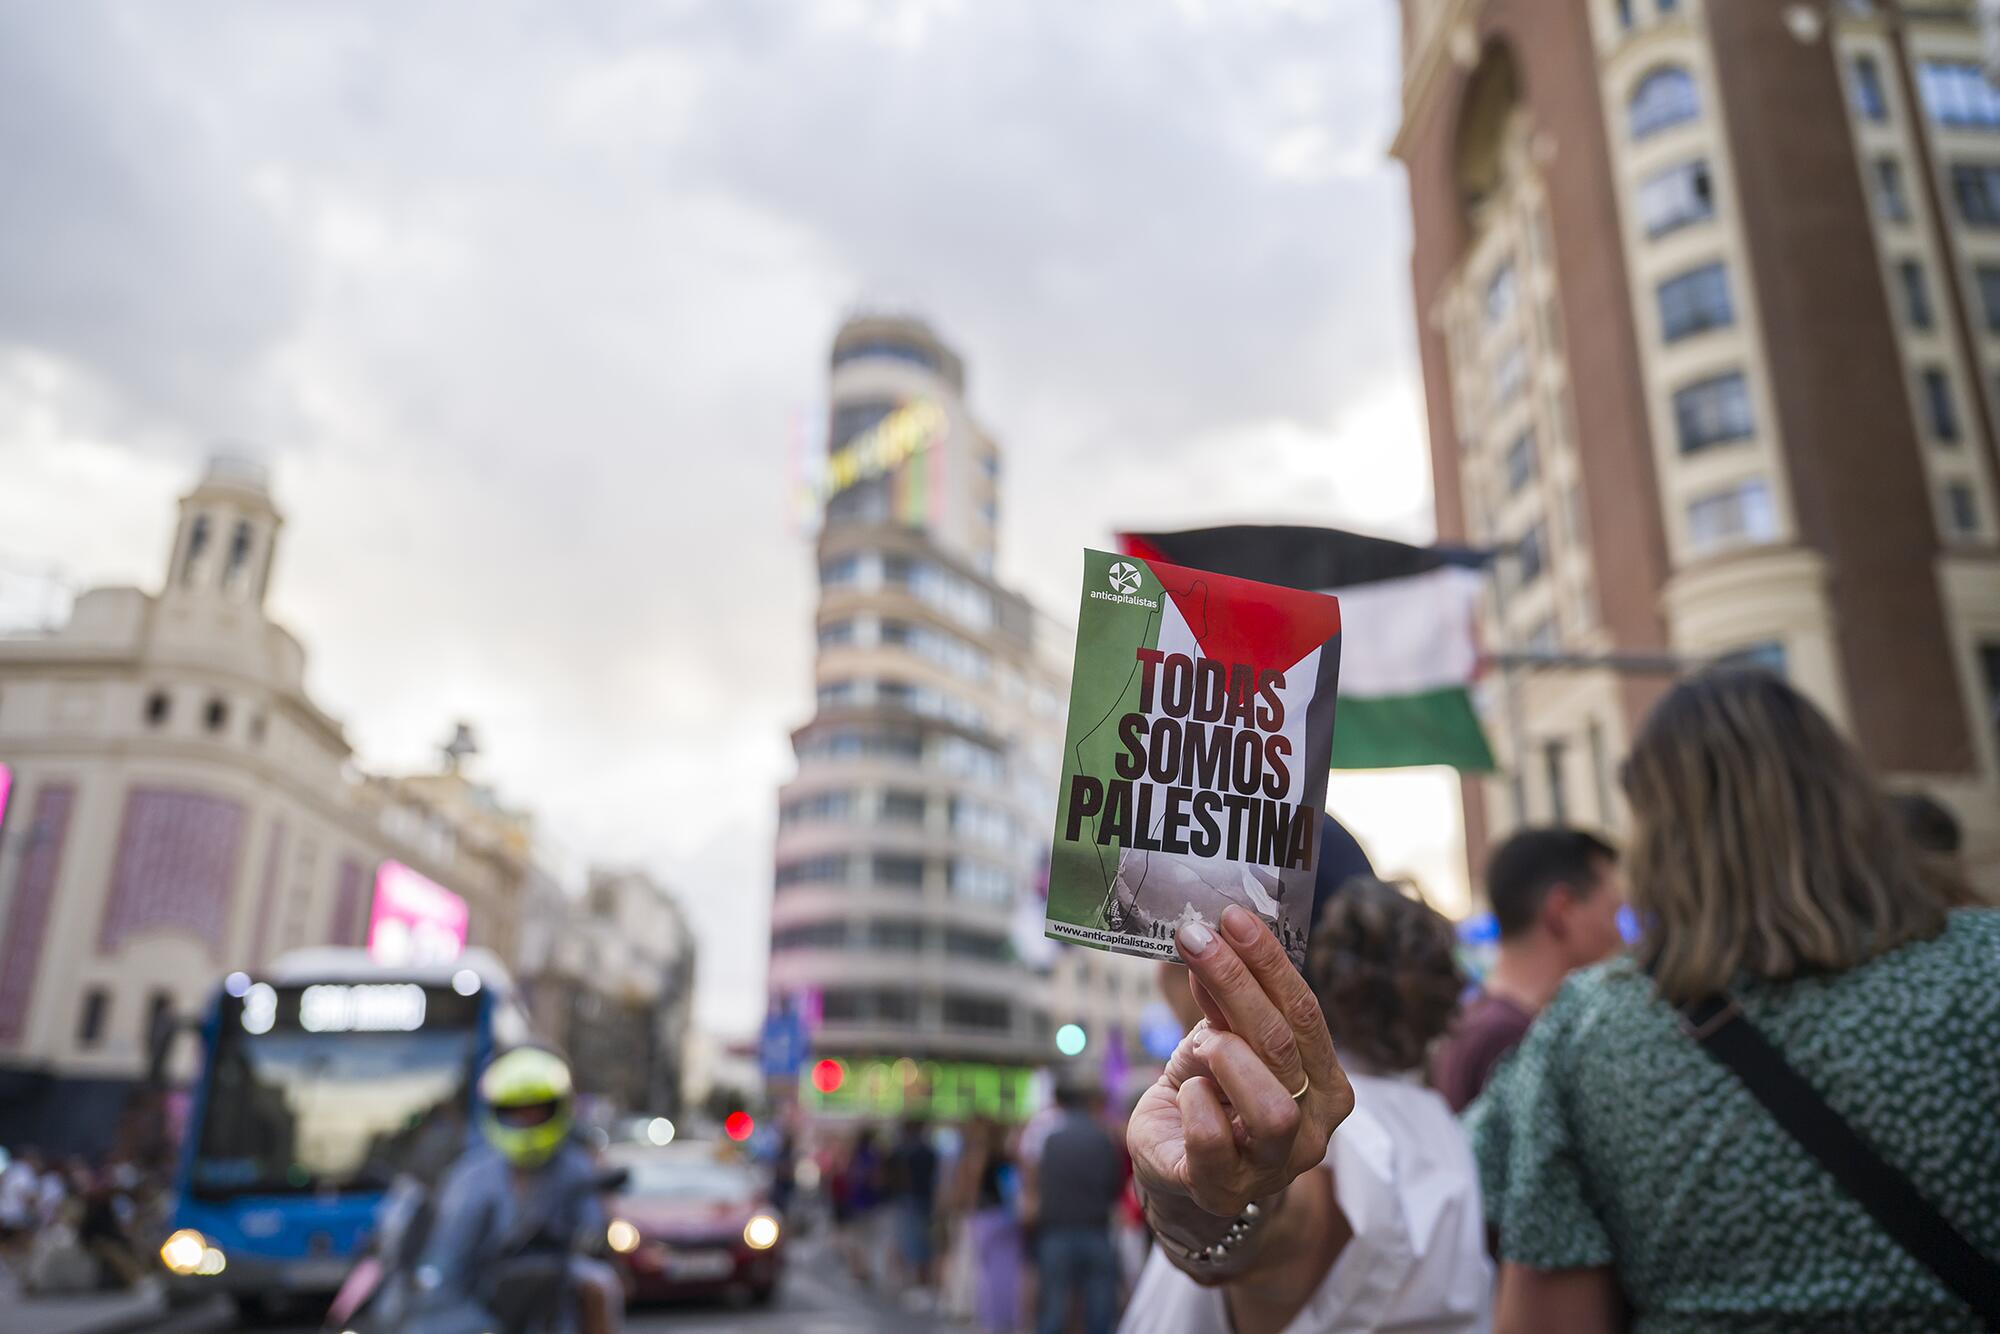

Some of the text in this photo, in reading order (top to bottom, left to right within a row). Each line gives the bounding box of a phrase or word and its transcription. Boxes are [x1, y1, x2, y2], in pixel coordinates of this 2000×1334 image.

[1090, 590, 1157, 608] anticapitalistas
[1136, 647, 1286, 733] TODAS
[1115, 712, 1292, 800] SOMOS
[1065, 774, 1314, 871] PALESTINA
[1053, 923, 1173, 954] www.anticapitalistas.org
